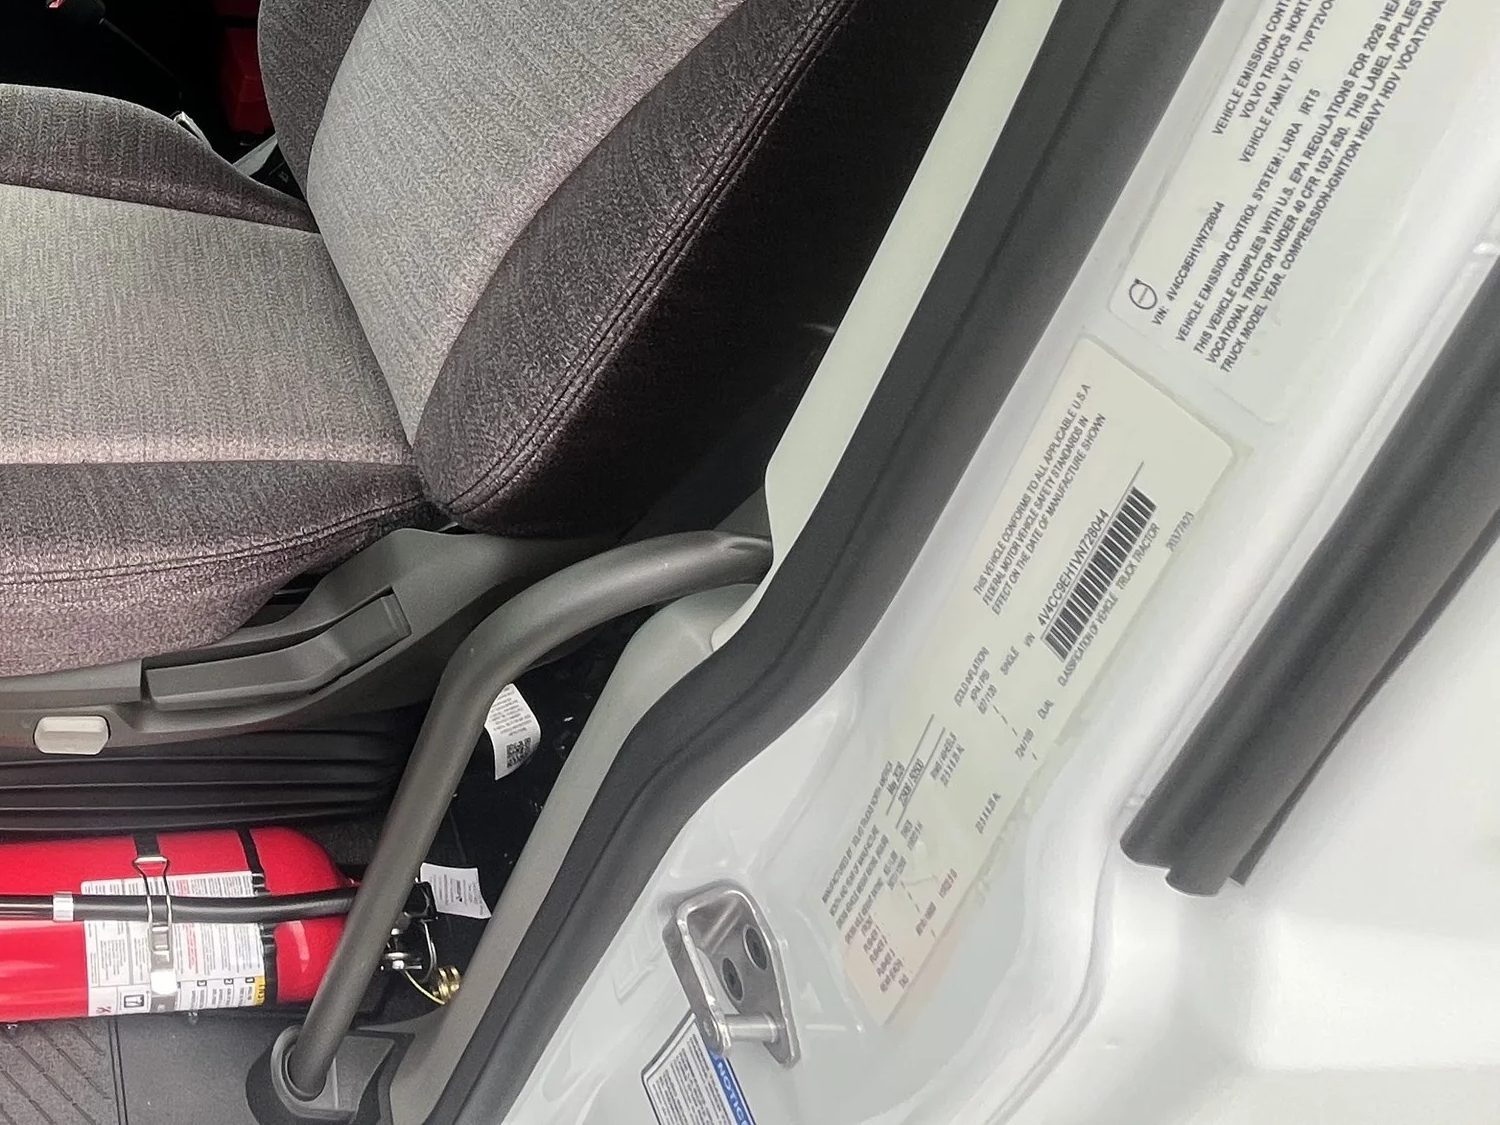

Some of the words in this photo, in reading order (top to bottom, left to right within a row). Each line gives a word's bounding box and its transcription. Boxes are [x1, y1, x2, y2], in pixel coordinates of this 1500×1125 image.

[1212, 88, 1244, 136] VEHICLE
[1236, 33, 1272, 88] EMISSION
[1238, 115, 1271, 164] VEHICLE
[1264, 73, 1294, 116] FAMILY
[1286, 56, 1303, 73] ID:
[1239, 80, 1267, 120] VOLVO
[1259, 33, 1291, 80] TRUCKS
[1175, 300, 1205, 342] VEHICLE
[1198, 250, 1231, 300] EMISSION
[1224, 200, 1259, 252] CONTROL
[1251, 151, 1286, 202] SYSTEM:
[1278, 120, 1303, 153] LRRA
[1193, 329, 1214, 355] THIS
[1206, 287, 1238, 331] VEHICLE
[1230, 234, 1268, 289] COMPLIES
[1259, 205, 1284, 236] WITH
[1275, 183, 1296, 207] U.S.
[1288, 159, 1310, 184] EPA
[1302, 77, 1356, 160] REGULATIONS
[1347, 52, 1371, 78] FOR
[1205, 301, 1248, 364] VOCATIONAL
[1241, 251, 1277, 301] TRACTOR
[1269, 213, 1298, 252] UNDER
[1291, 198, 1307, 214] 40
[1299, 174, 1320, 199] CFR
[1344, 91, 1368, 120] THIS
[1361, 51, 1392, 90] LABEL
[1220, 338, 1247, 373] TRUCK
[1240, 301, 1268, 339] MODEL
[1279, 139, 1362, 270] COMPRESSION-IGNITION
[1355, 99, 1386, 139] HEAVY
[1378, 72, 1402, 98] HDV
[1152, 304, 1170, 326] VIN:
[973, 575, 987, 594] THIS
[983, 541, 1006, 576] VEHICLE
[1001, 493, 1031, 542] CONFORMS
[1027, 479, 1038, 494] TO
[1034, 463, 1047, 481] ALL
[1043, 408, 1076, 464] APPLICABLE
[982, 570, 1005, 606] FEDERAL
[1000, 540, 1020, 572] MOTOR
[1016, 508, 1038, 542] VEHICLE
[1033, 475, 1055, 510] SAFETY
[1050, 425, 1082, 478] STANDARDS
[1077, 414, 1088, 427] IN
[991, 581, 1014, 614] EFFECT
[1008, 568, 1021, 584] ON
[1016, 550, 1030, 570] THE
[1025, 528, 1042, 553] DATE
[1038, 513, 1050, 530] OF
[1045, 449, 1085, 516] MANUFACTURE
[1081, 412, 1105, 451] SHOWN
[1036, 507, 1109, 626] 4V4CC9EH1VN728044
[1116, 560, 1137, 590] TRUCK
[1132, 521, 1161, 563] TRACTOR
[1024, 631, 1035, 647] VIN
